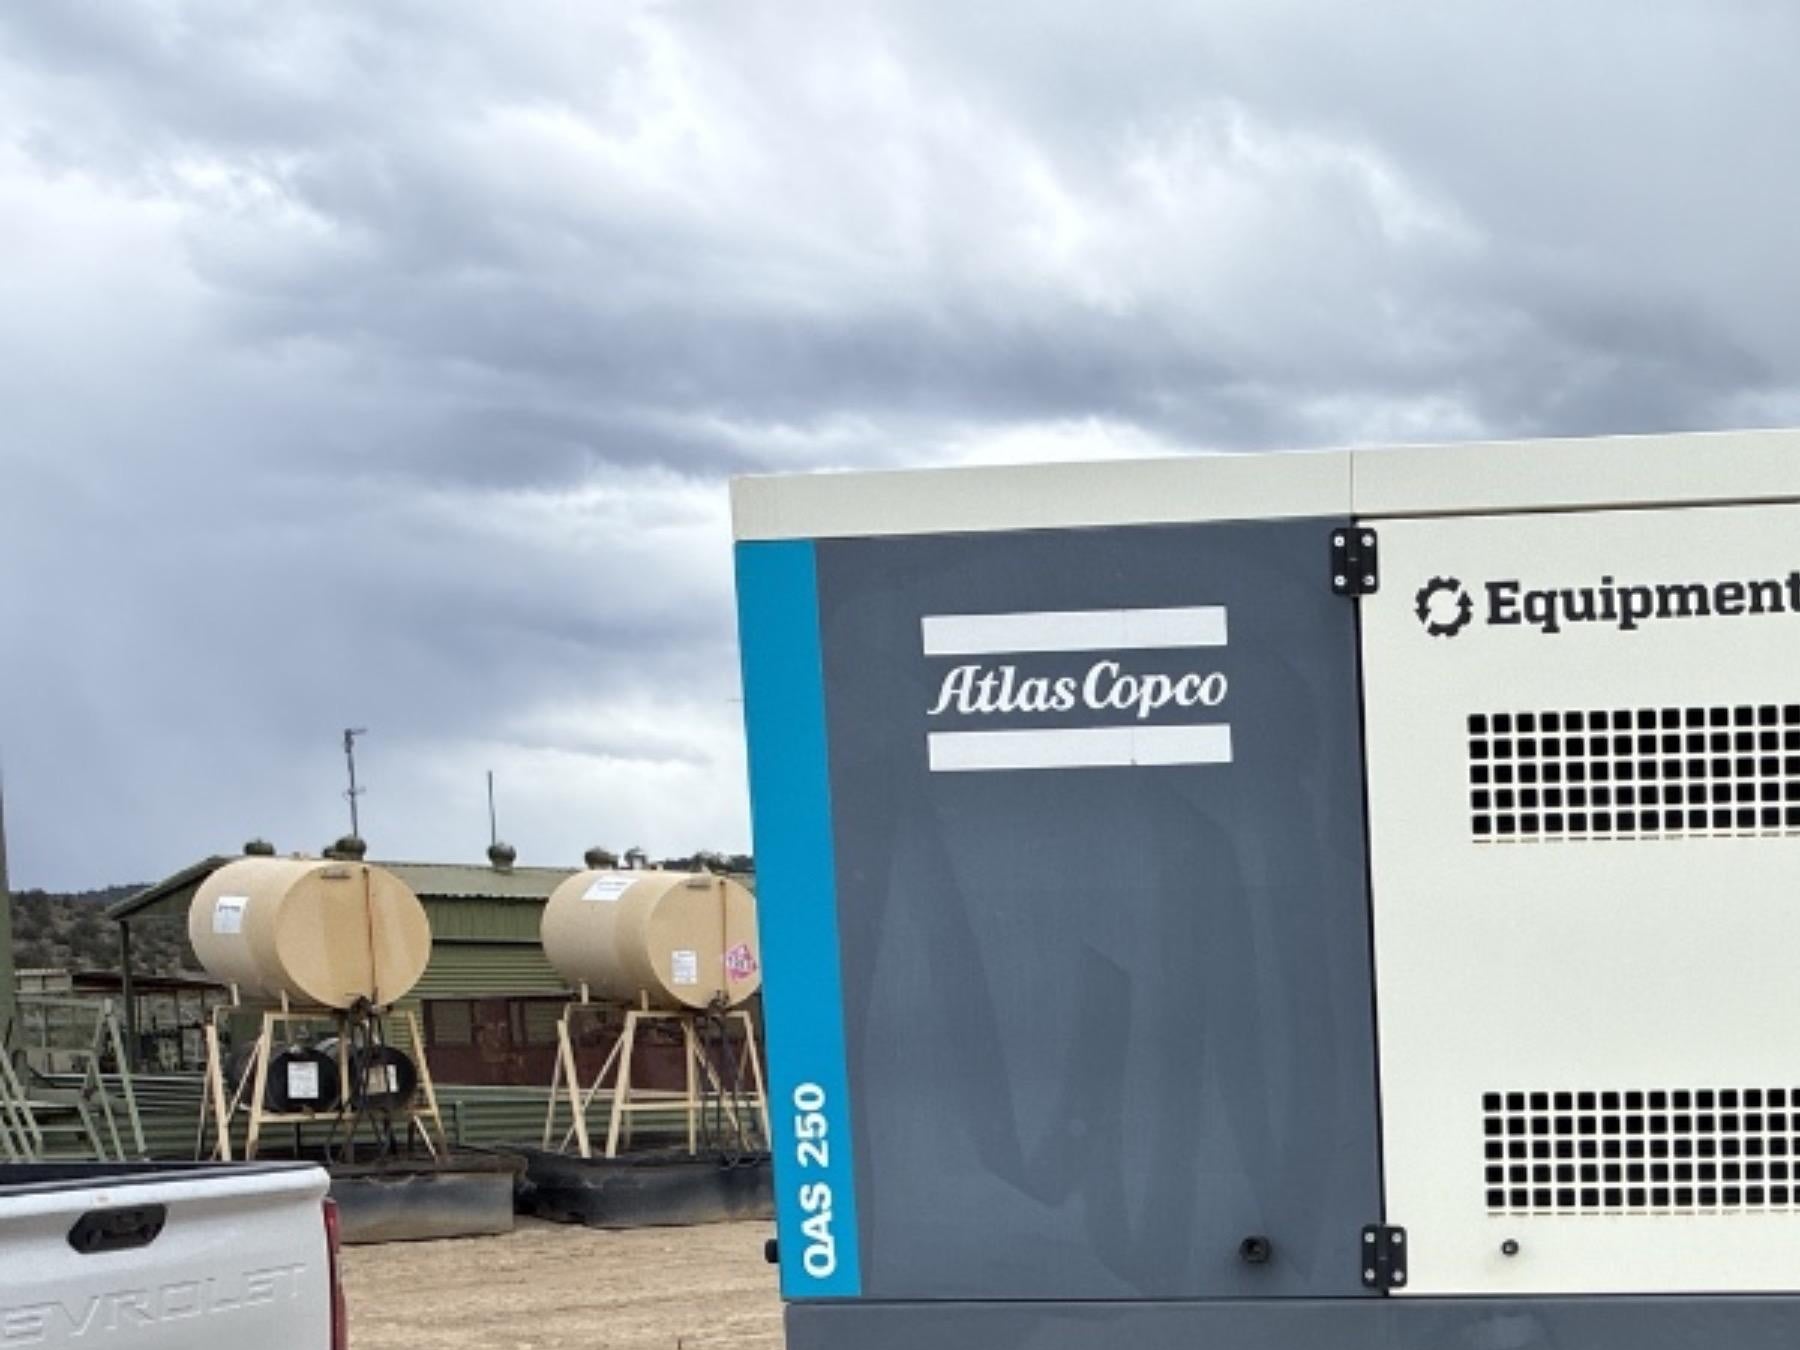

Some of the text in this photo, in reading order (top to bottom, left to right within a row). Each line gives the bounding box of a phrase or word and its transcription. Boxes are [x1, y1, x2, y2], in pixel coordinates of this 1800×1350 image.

[926, 659, 1229, 720] Atlas Copco
[793, 1081, 837, 1279] QAS 250
